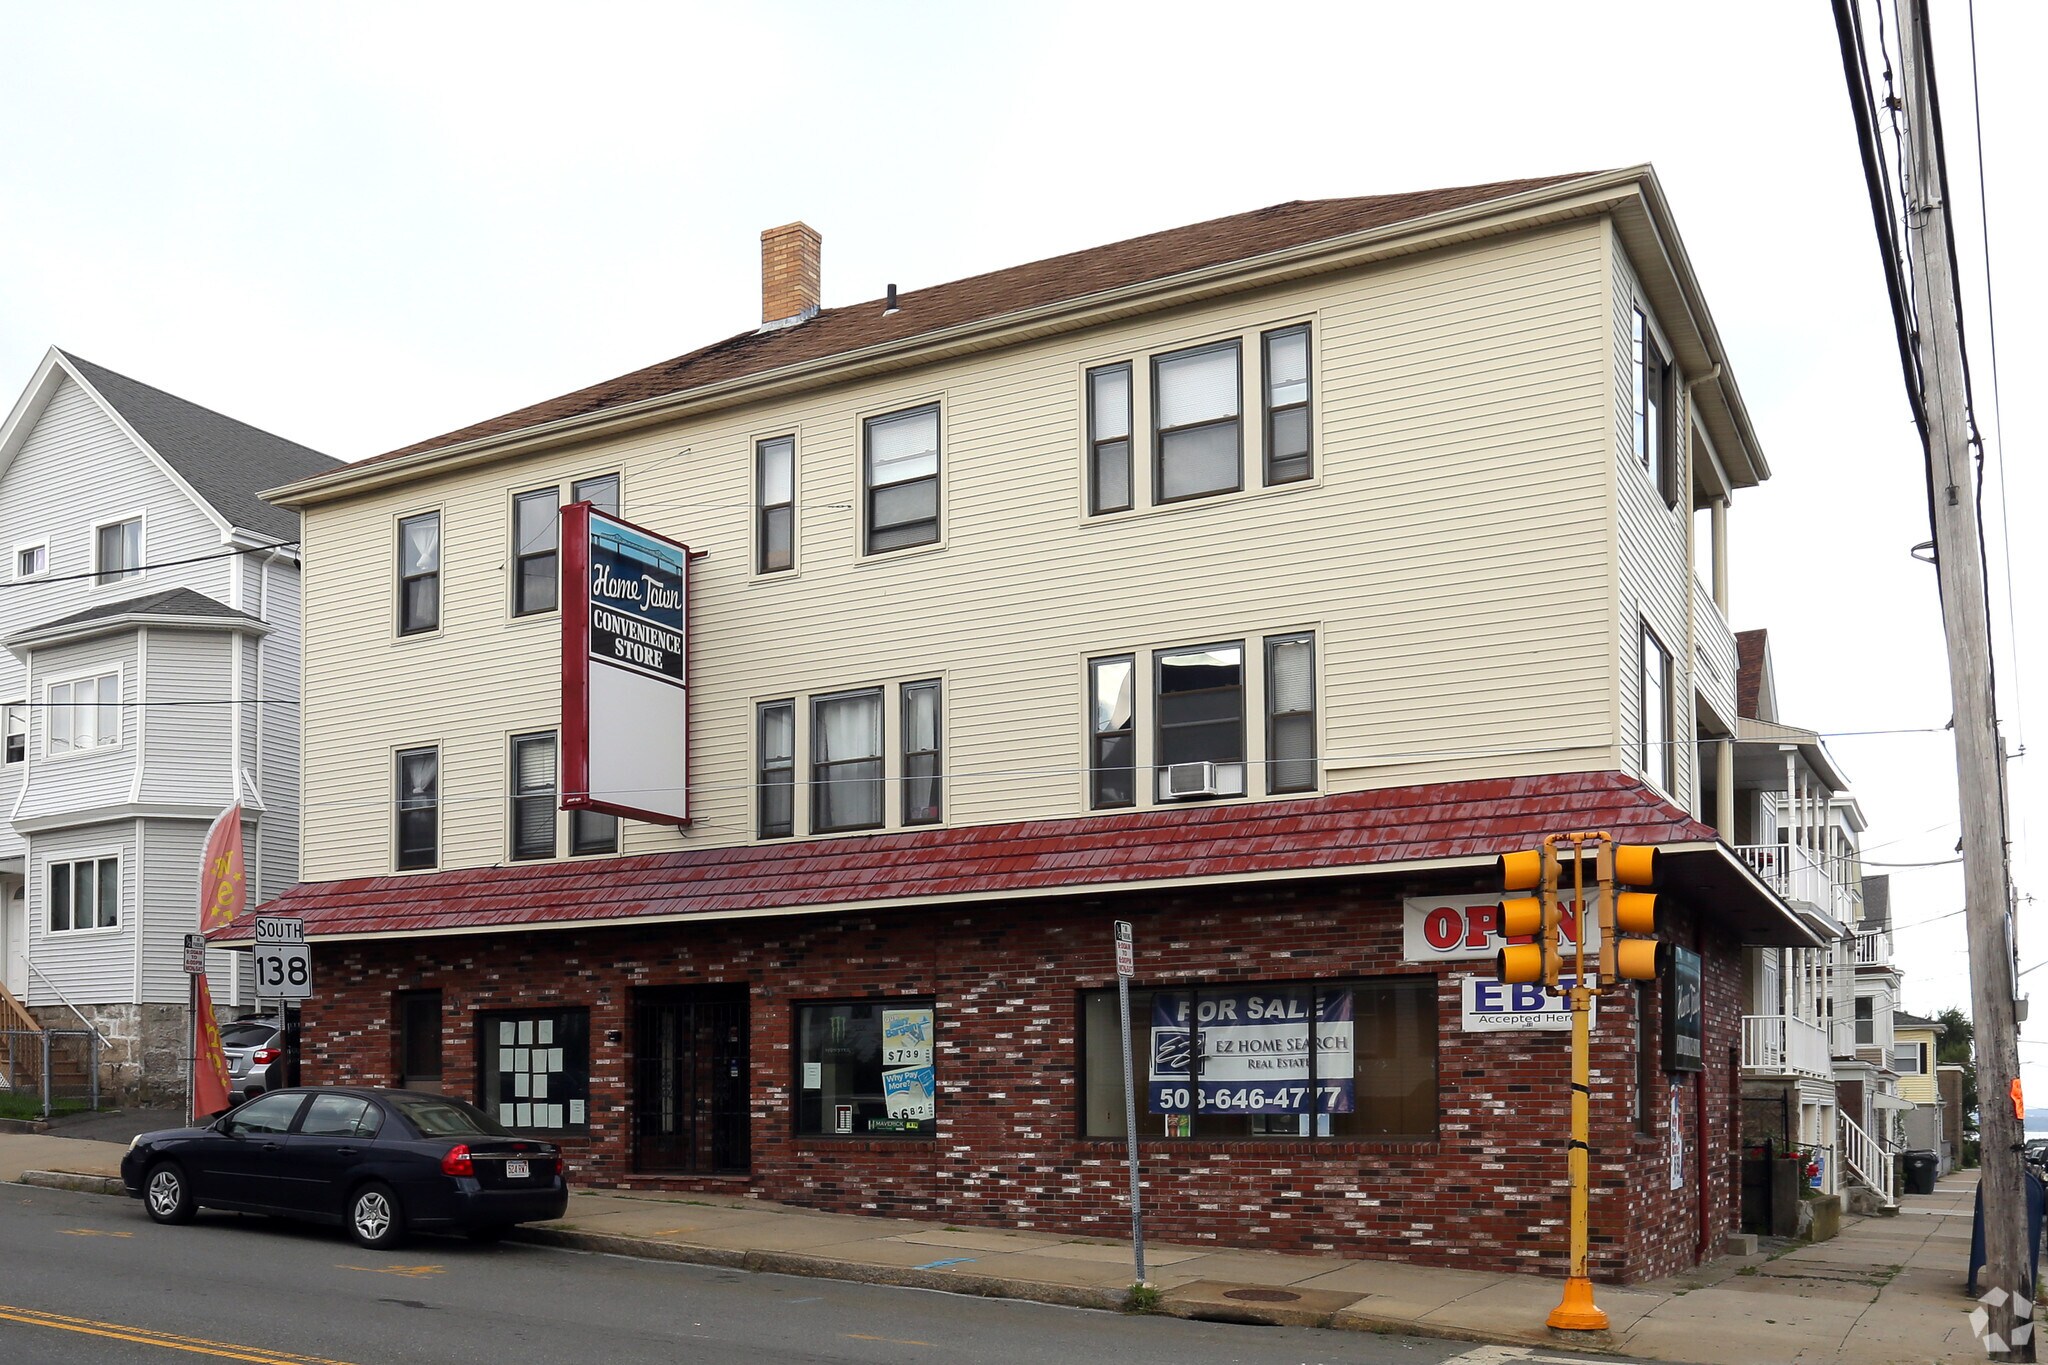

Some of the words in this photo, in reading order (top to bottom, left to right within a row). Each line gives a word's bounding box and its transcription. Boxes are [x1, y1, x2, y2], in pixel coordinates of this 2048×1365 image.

[593, 563, 642, 600] Home
[640, 574, 682, 611] Town
[594, 609, 681, 654] CONVENIENCE
[615, 638, 663, 669] STORE
[257, 919, 302, 938] SOUTH
[256, 956, 308, 986] 138
[1479, 1015, 1541, 1025] Accepted
[1215, 1040, 1233, 1053] EZ
[1238, 1039, 1283, 1053] HOME
[886, 1073, 904, 1083] Why
[904, 1071, 919, 1080] Pay
[888, 1080, 911, 1091] More?
